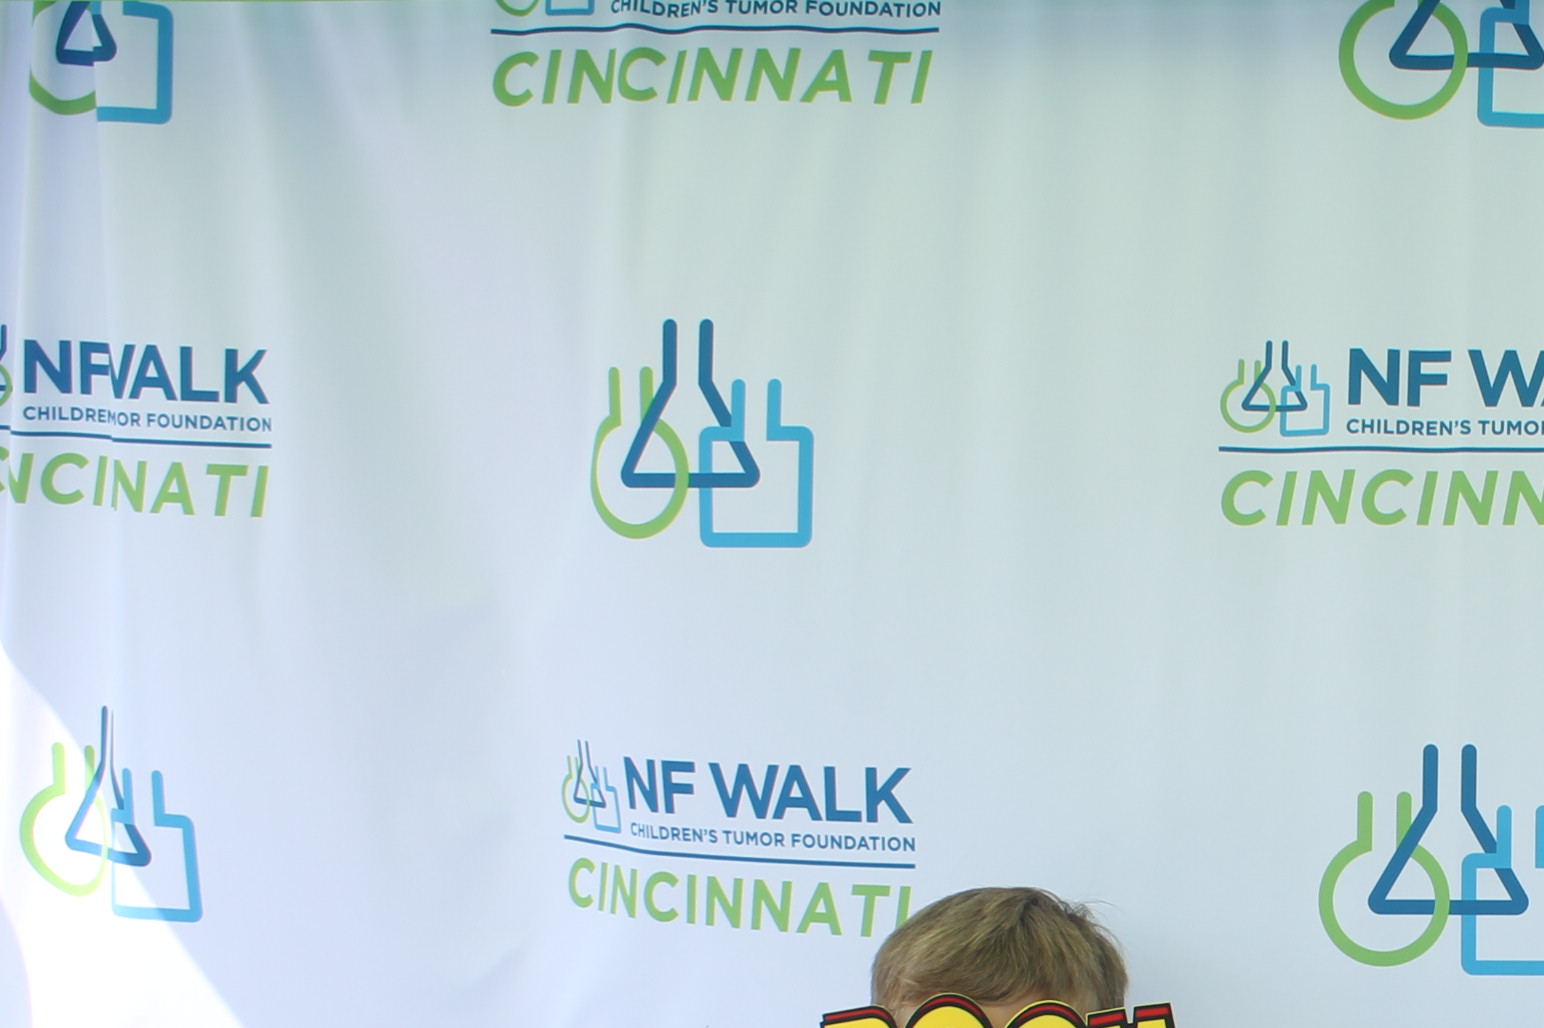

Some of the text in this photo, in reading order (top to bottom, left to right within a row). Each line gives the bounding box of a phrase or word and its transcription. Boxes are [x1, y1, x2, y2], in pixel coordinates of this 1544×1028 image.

[611, 0, 941, 18] CHILDREN'S TUMOR FOUNDATION
[493, 47, 933, 106] CINCINNATI
[23, 339, 110, 395] NF
[1346, 348, 1452, 407] NF
[147, 413, 272, 432] FOUNDATION
[1346, 418, 1472, 437] CHILDREN'S
[623, 756, 914, 824] NF WALK
[630, 822, 916, 852] CHILDREN'S TUMOR FOUNDATION
[568, 857, 911, 937] CINCINNATI
